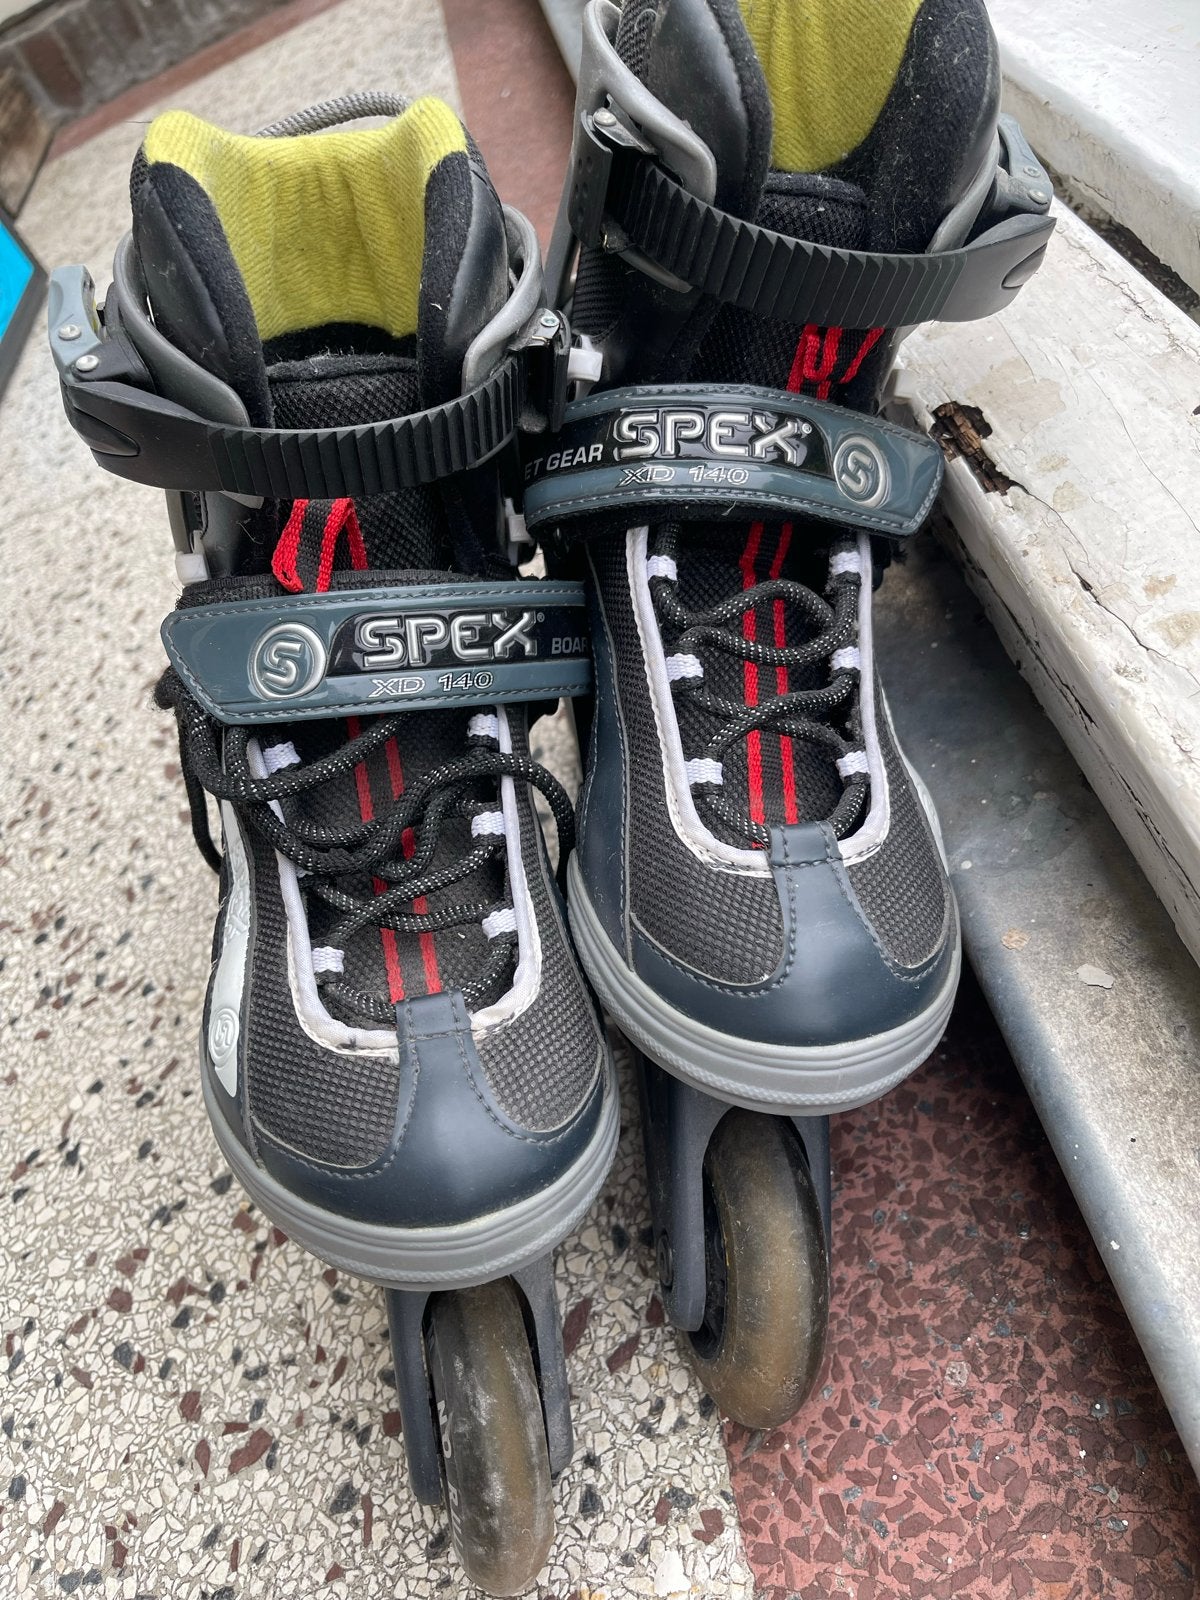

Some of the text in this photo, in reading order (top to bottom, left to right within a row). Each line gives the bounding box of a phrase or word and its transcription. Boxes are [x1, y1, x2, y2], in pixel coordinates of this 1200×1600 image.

[546, 443, 604, 471] GEAR
[616, 465, 750, 488] XD 140
[369, 671, 494, 698] XD 140
